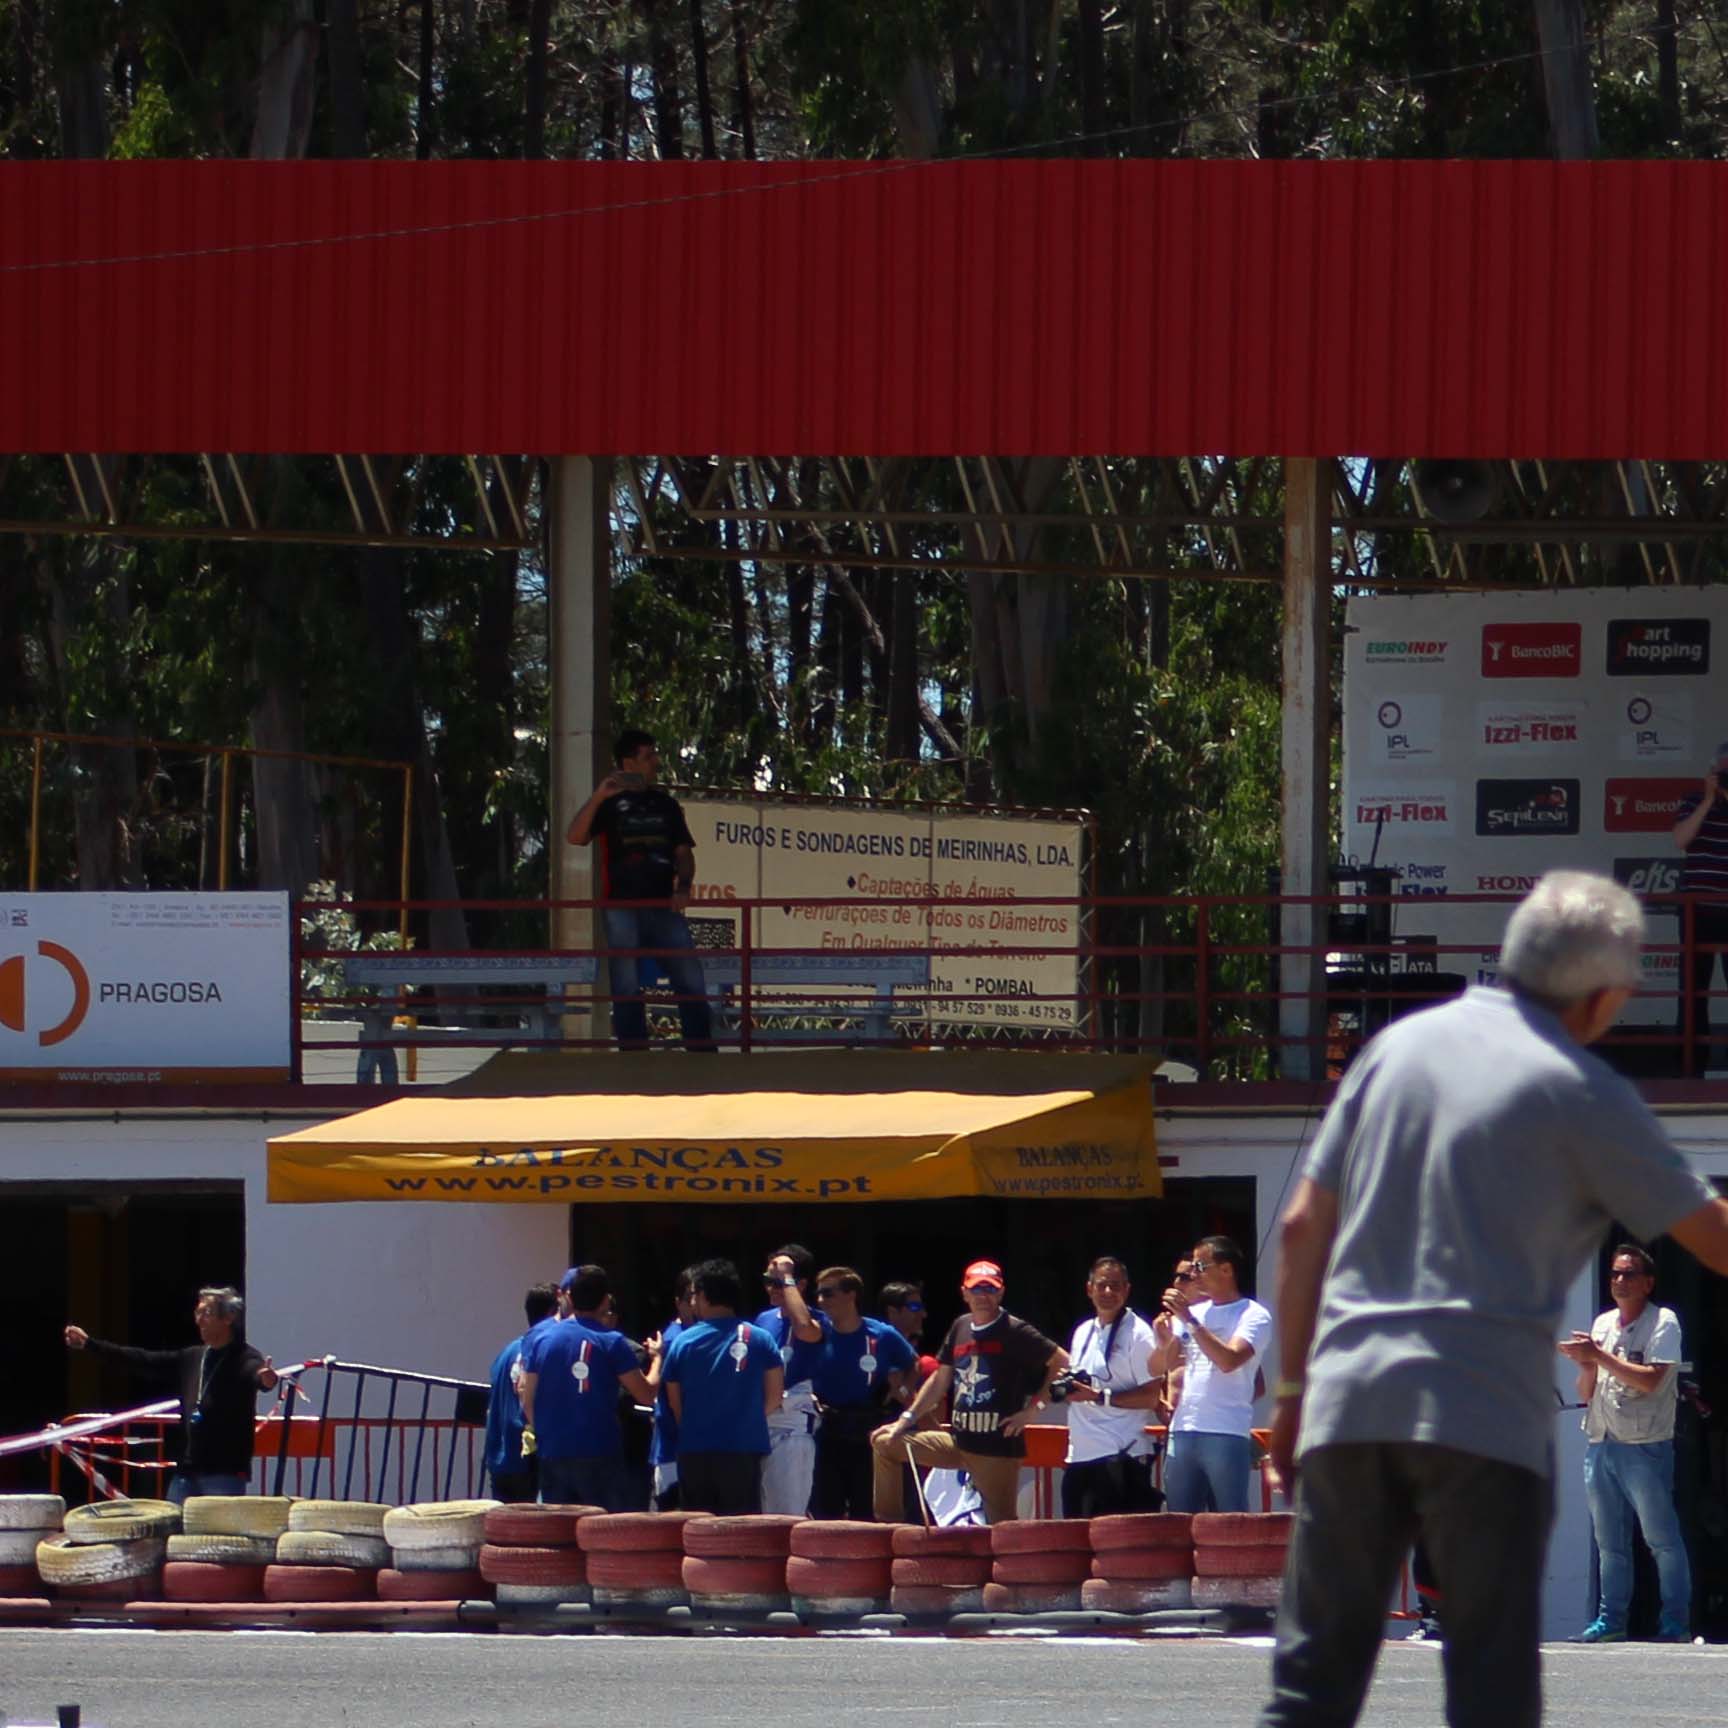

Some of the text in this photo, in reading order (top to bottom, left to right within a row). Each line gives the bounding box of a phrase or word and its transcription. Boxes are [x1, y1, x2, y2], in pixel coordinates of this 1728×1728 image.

[1511, 643, 1575, 660] BancoBIC
[715, 822, 1075, 867] FUROS E SONDAGENS DE MEIRINHAS, LDA.
[1407, 863, 1447, 879] Power
[857, 872, 940, 900] Captações
[943, 879, 962, 898] de
[1477, 875, 1535, 891] HON
[892, 907, 912, 924] de
[917, 905, 963, 928] Todos
[968, 914, 985, 929] os
[989, 910, 1068, 934] Diâmetros
[821, 931, 846, 949] Em
[99, 982, 223, 1003] PRAGOSA
[975, 977, 1036, 996] POMBAL
[472, 1146, 784, 1174] BALANÇAS
[385, 1173, 873, 1198] www.pestronix.pt
